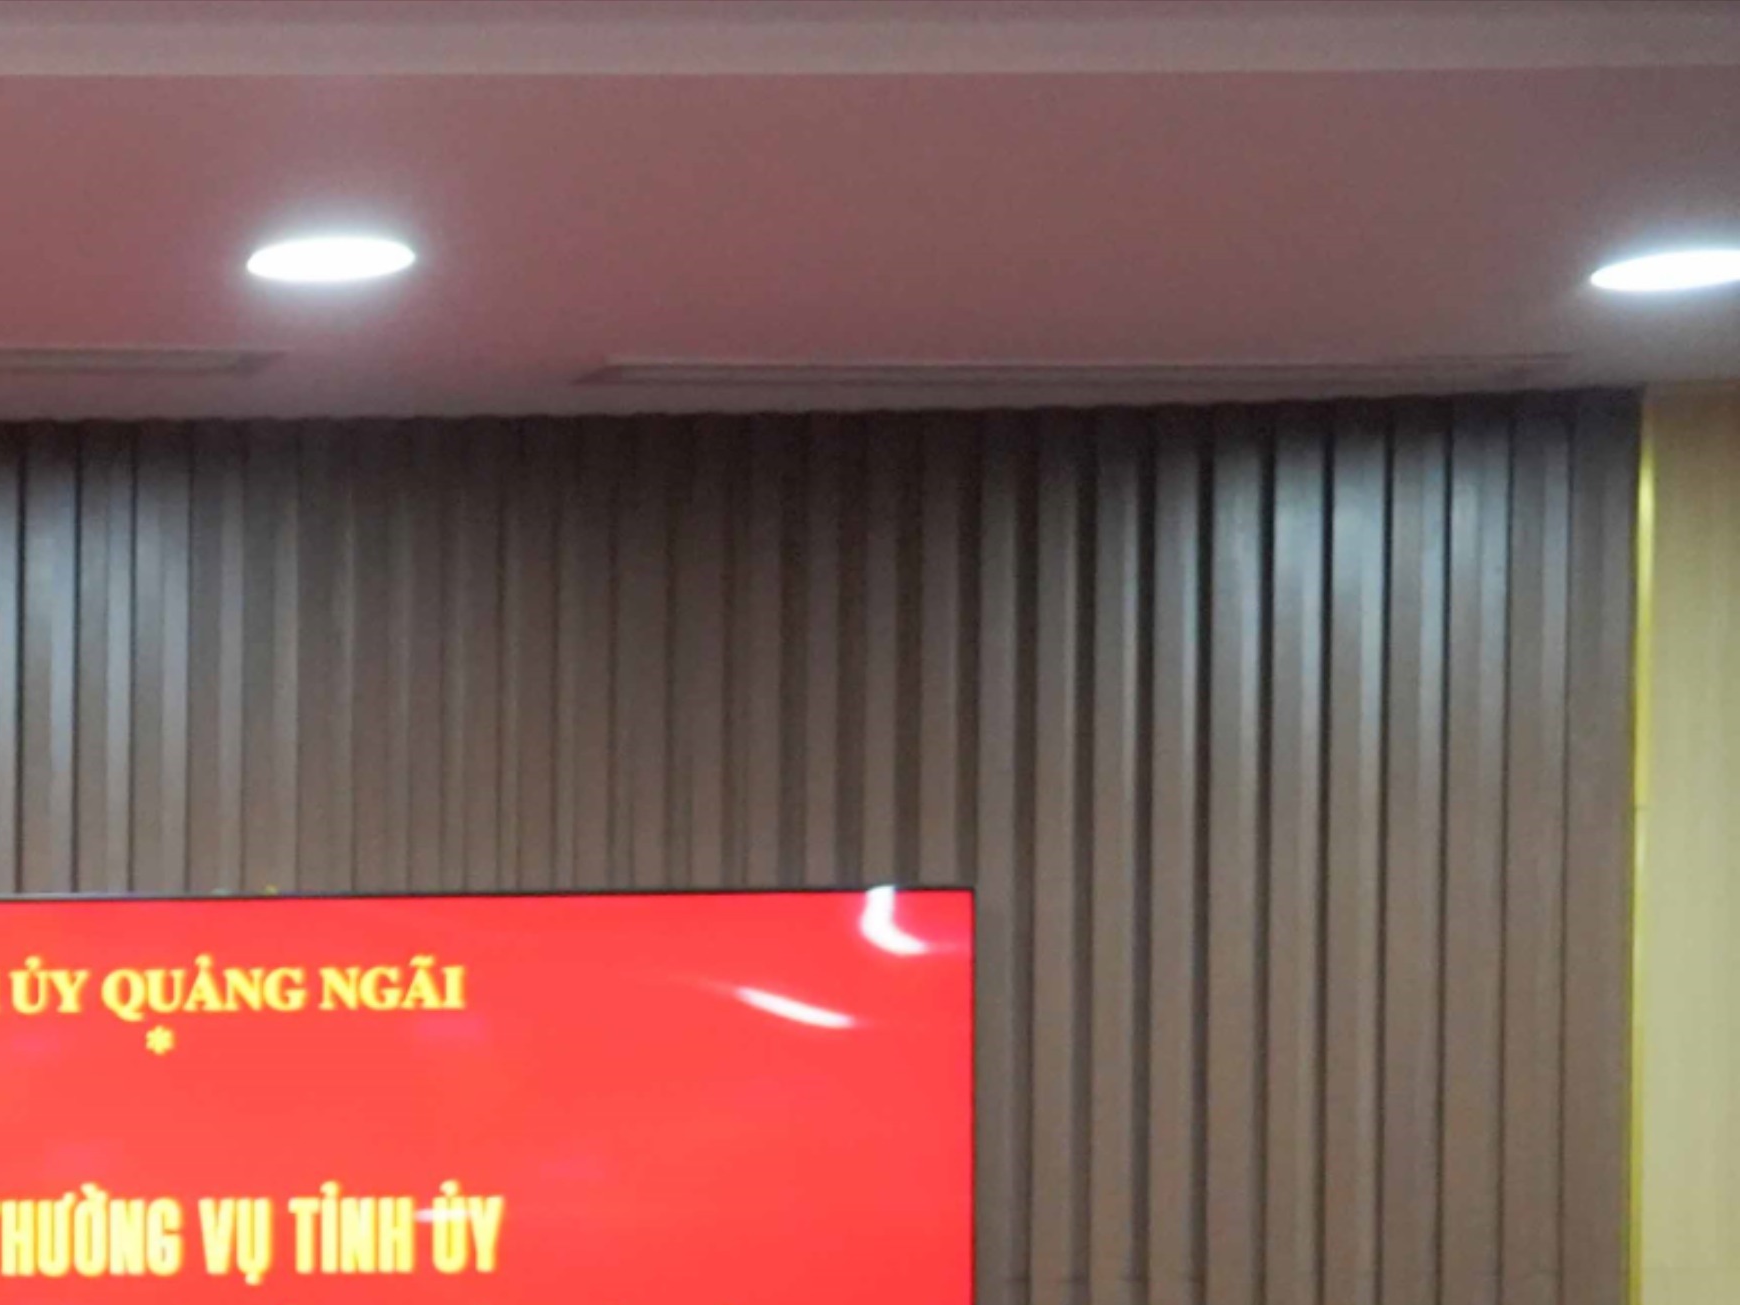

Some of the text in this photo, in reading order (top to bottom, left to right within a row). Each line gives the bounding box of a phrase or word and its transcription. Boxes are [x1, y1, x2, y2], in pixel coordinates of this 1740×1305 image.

[8, 956, 90, 1014] ỦY
[102, 955, 306, 1021] QUẢNG
[318, 956, 467, 1010] NGÃI
[198, 1198, 272, 1284] VỤ
[289, 1180, 415, 1274] TỈNH
[431, 1179, 504, 1273] ỦY
